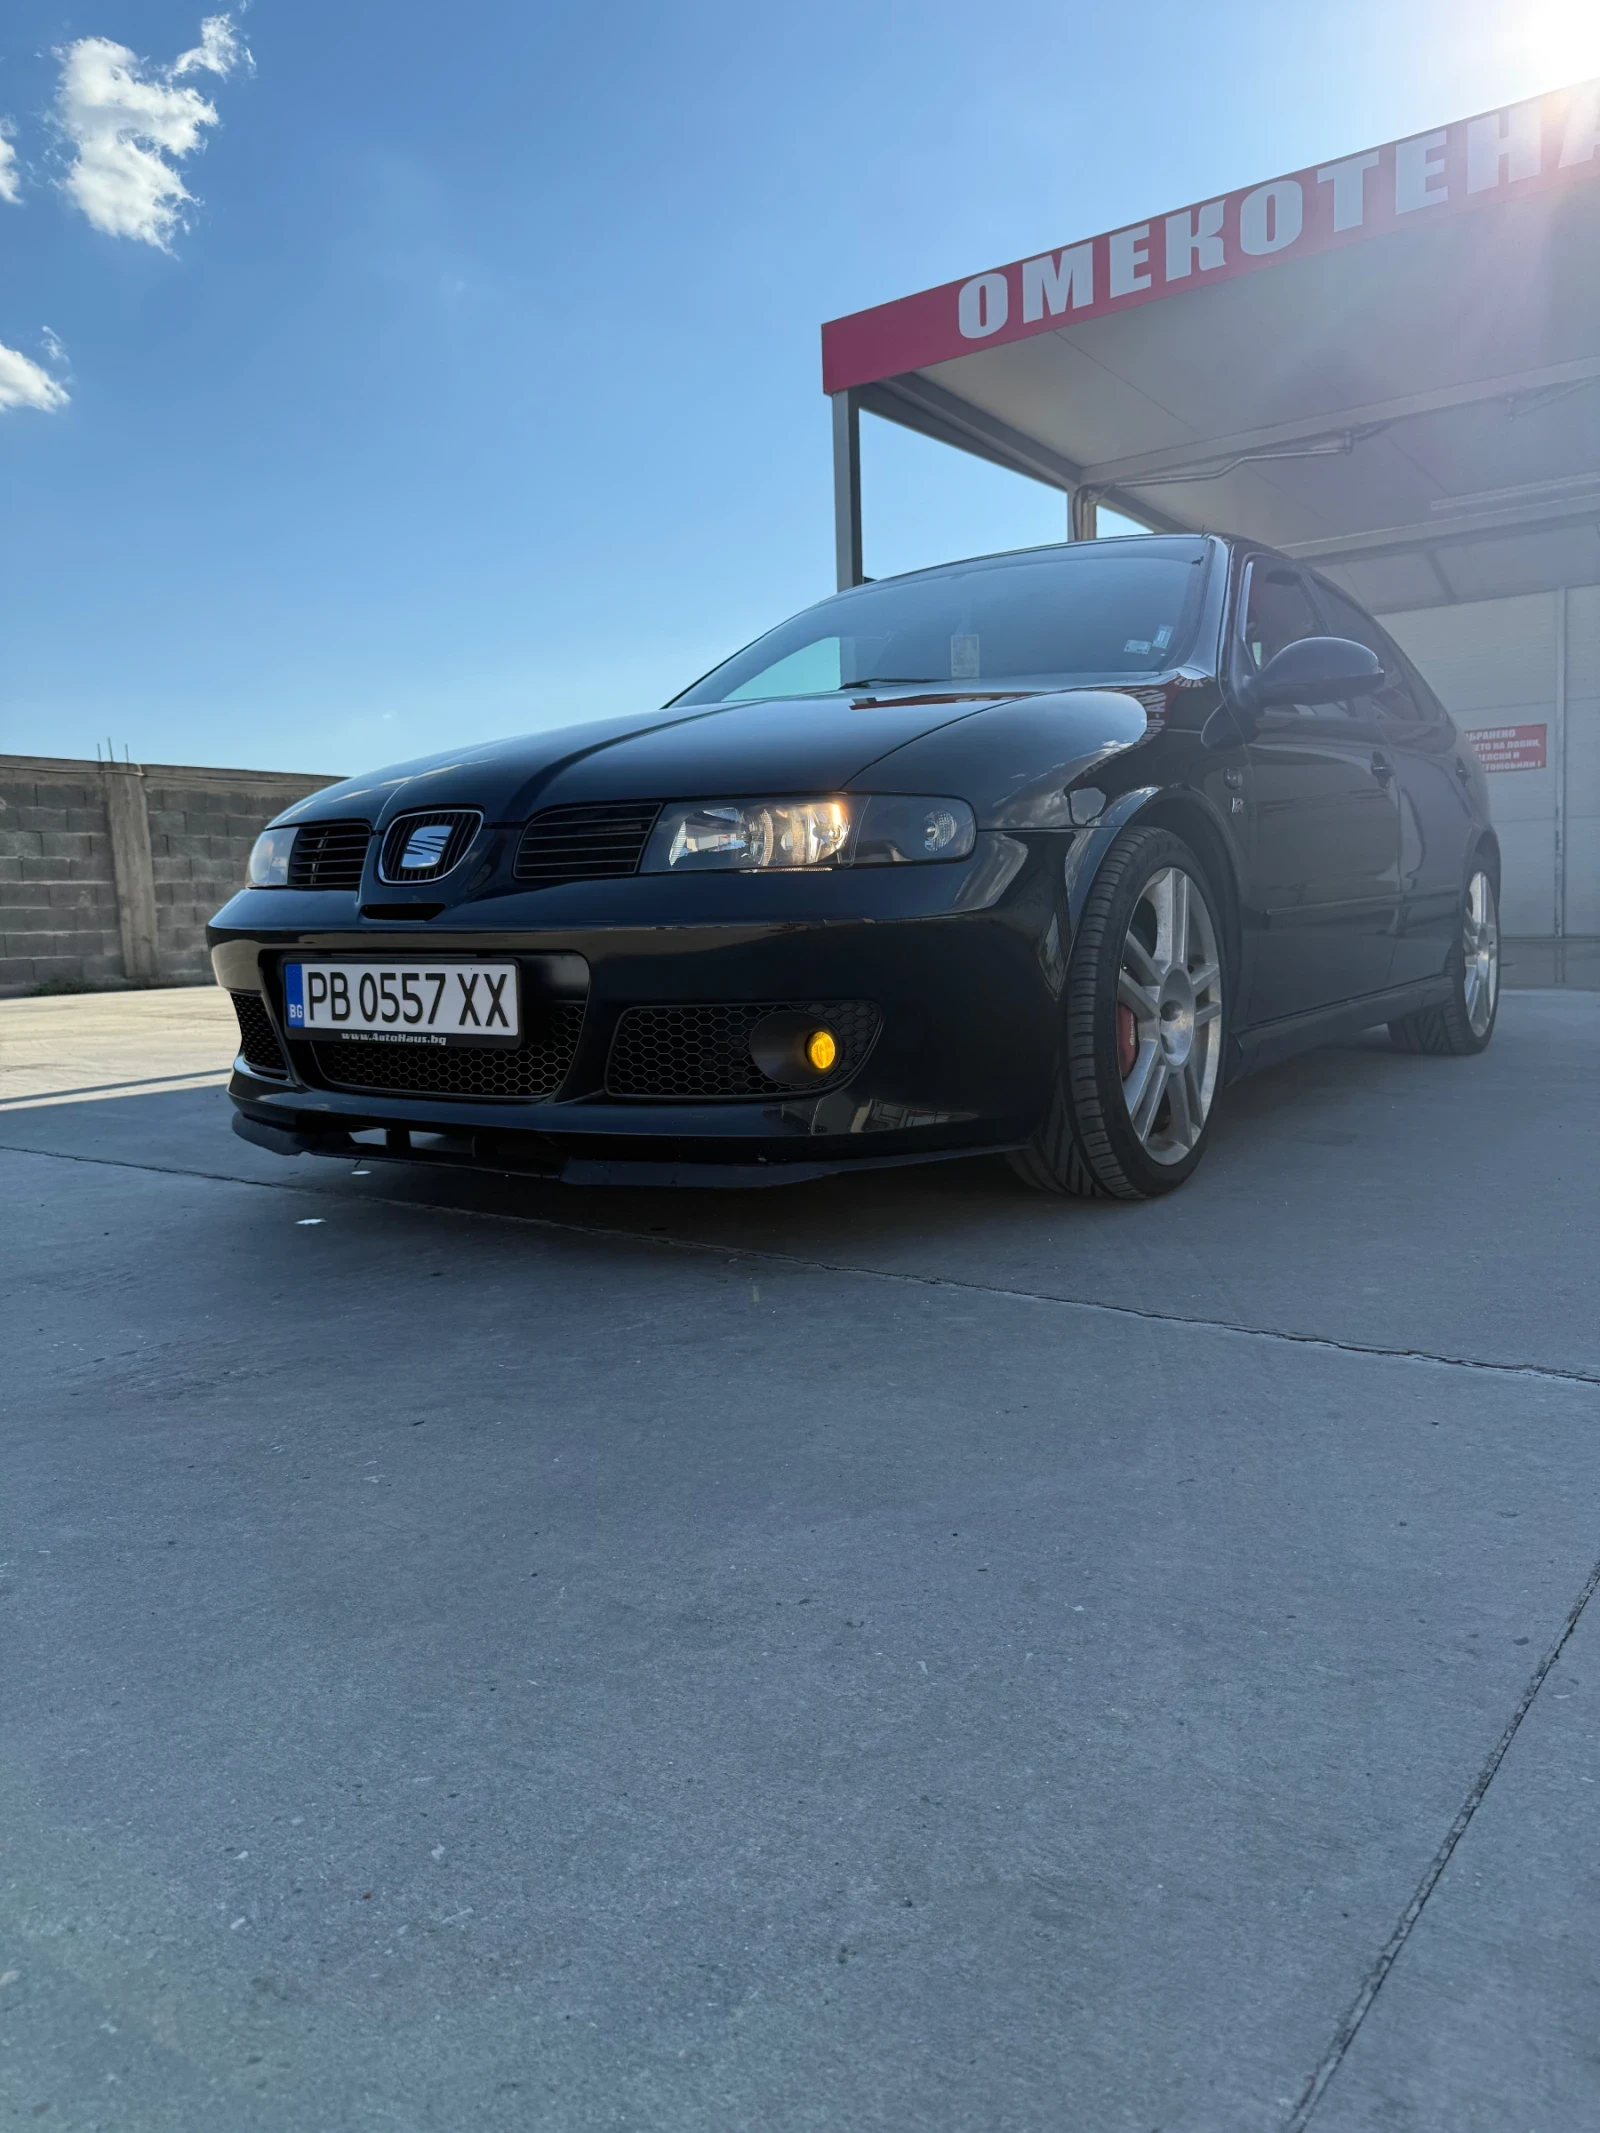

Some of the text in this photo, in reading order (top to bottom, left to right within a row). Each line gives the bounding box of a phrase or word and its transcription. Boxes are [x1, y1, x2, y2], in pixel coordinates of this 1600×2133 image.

[1472, 743, 1491, 752] ЕТО
[1493, 741, 1506, 750] НА
[1482, 761, 1535, 771] ТОМОБИЛИ
[308, 971, 510, 1027] PB 0557 XX
[289, 1004, 303, 1019] BG
[341, 1032, 447, 1046] www.AutoHaus.bg
